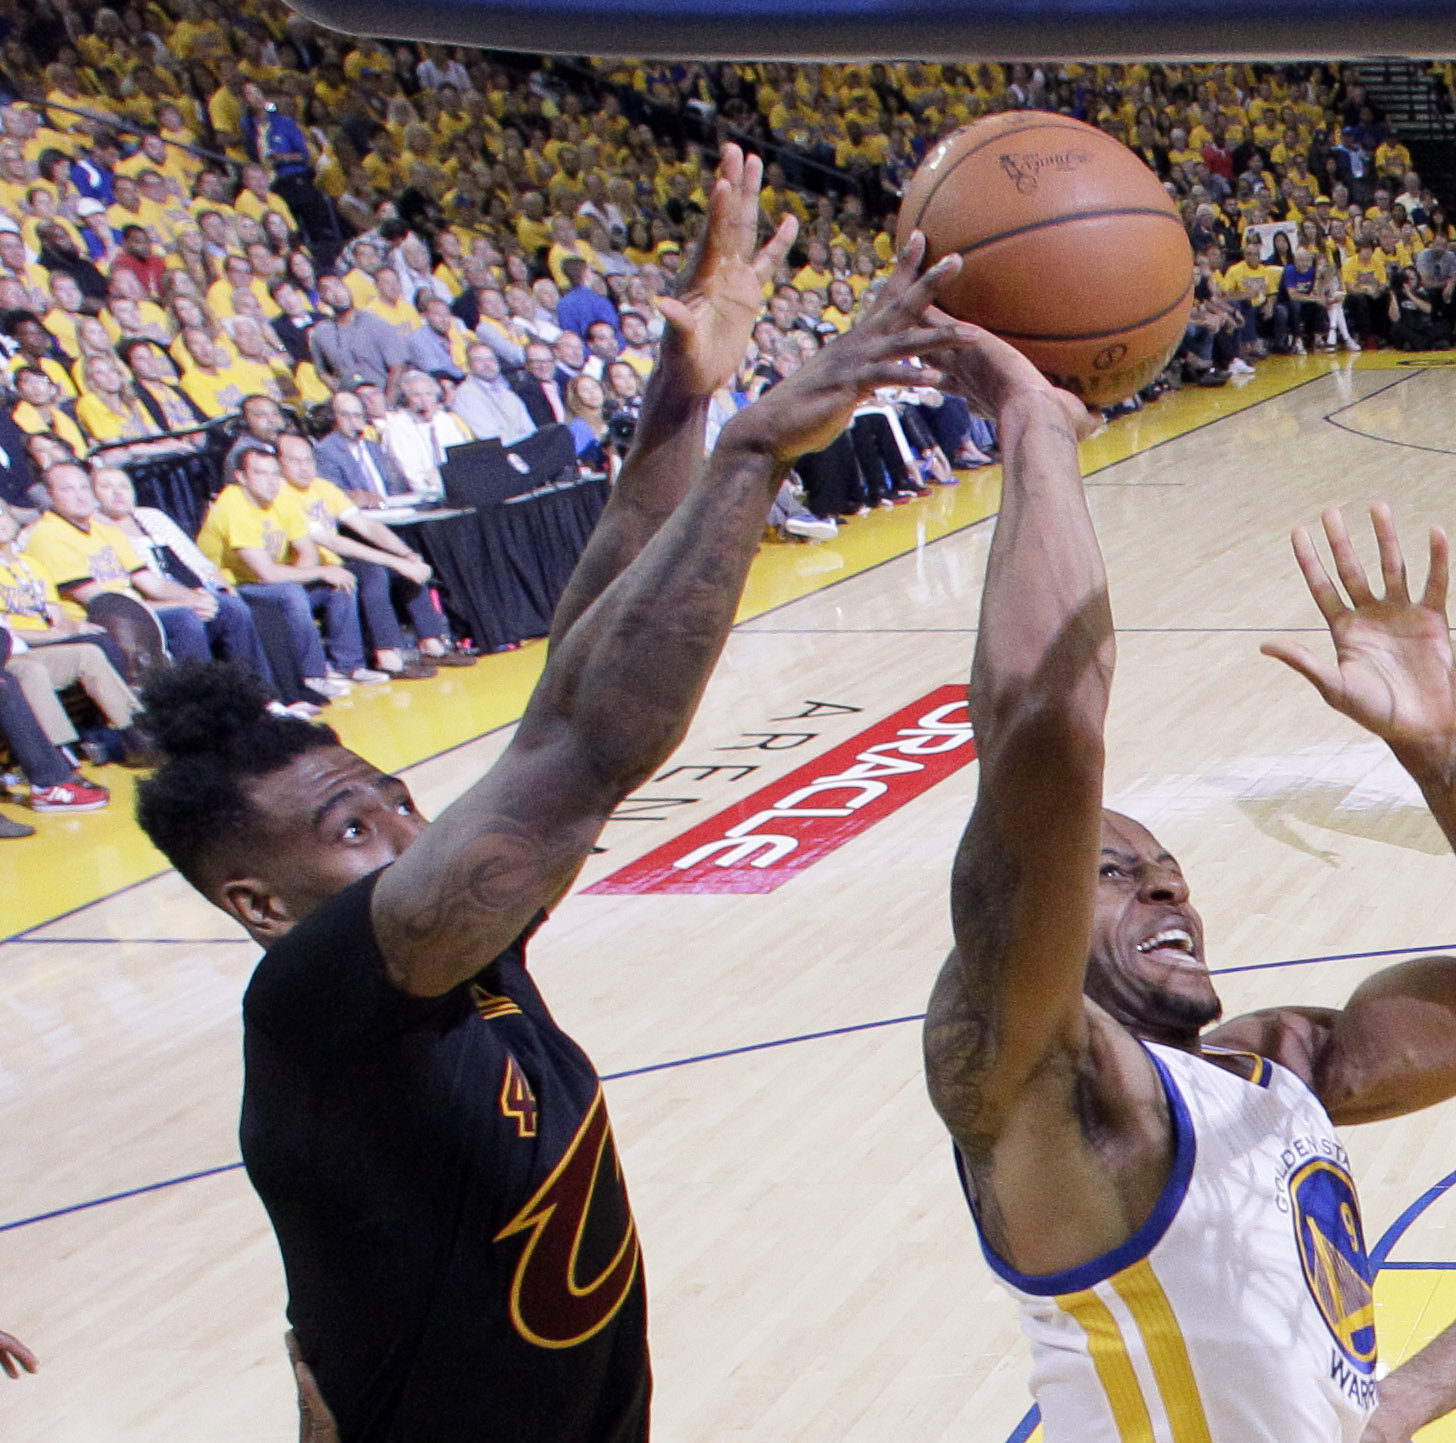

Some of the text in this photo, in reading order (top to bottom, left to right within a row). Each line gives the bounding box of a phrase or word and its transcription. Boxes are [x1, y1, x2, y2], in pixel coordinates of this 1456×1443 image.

[592, 700, 864, 855] AREN
[672, 700, 976, 870] ORACLE
[499, 1050, 537, 1138] 4
[1274, 1136, 1319, 1214] GOLDEN
